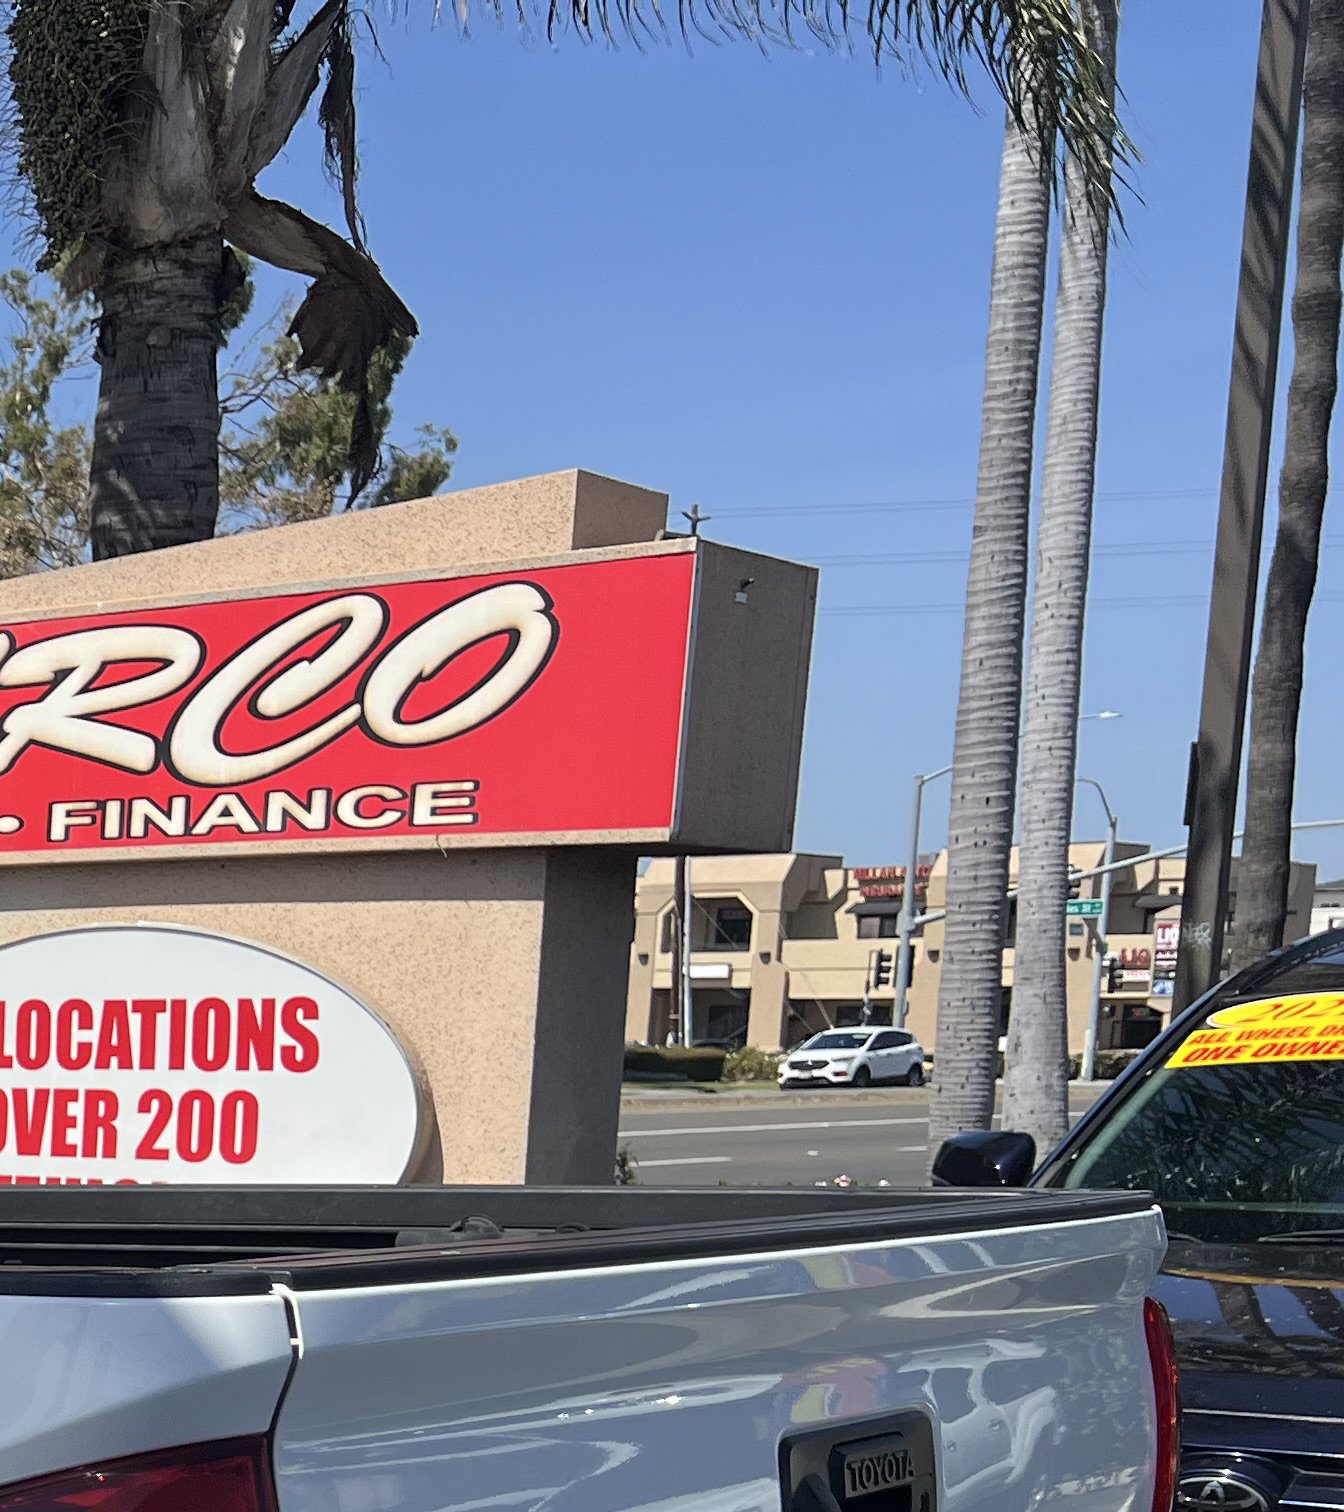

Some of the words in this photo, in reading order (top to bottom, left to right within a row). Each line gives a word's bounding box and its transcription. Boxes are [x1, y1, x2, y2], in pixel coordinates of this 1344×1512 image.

[47, 780, 480, 843] FINANCE
[1182, 1044, 1251, 1063] ONE
[1252, 1041, 1344, 1058] OWNE
[1187, 1031, 1233, 1046] ALL
[1236, 1026, 1312, 1042] WHEEL
[135, 1089, 259, 1164] 200
[846, 1449, 914, 1492] TOYOTA
